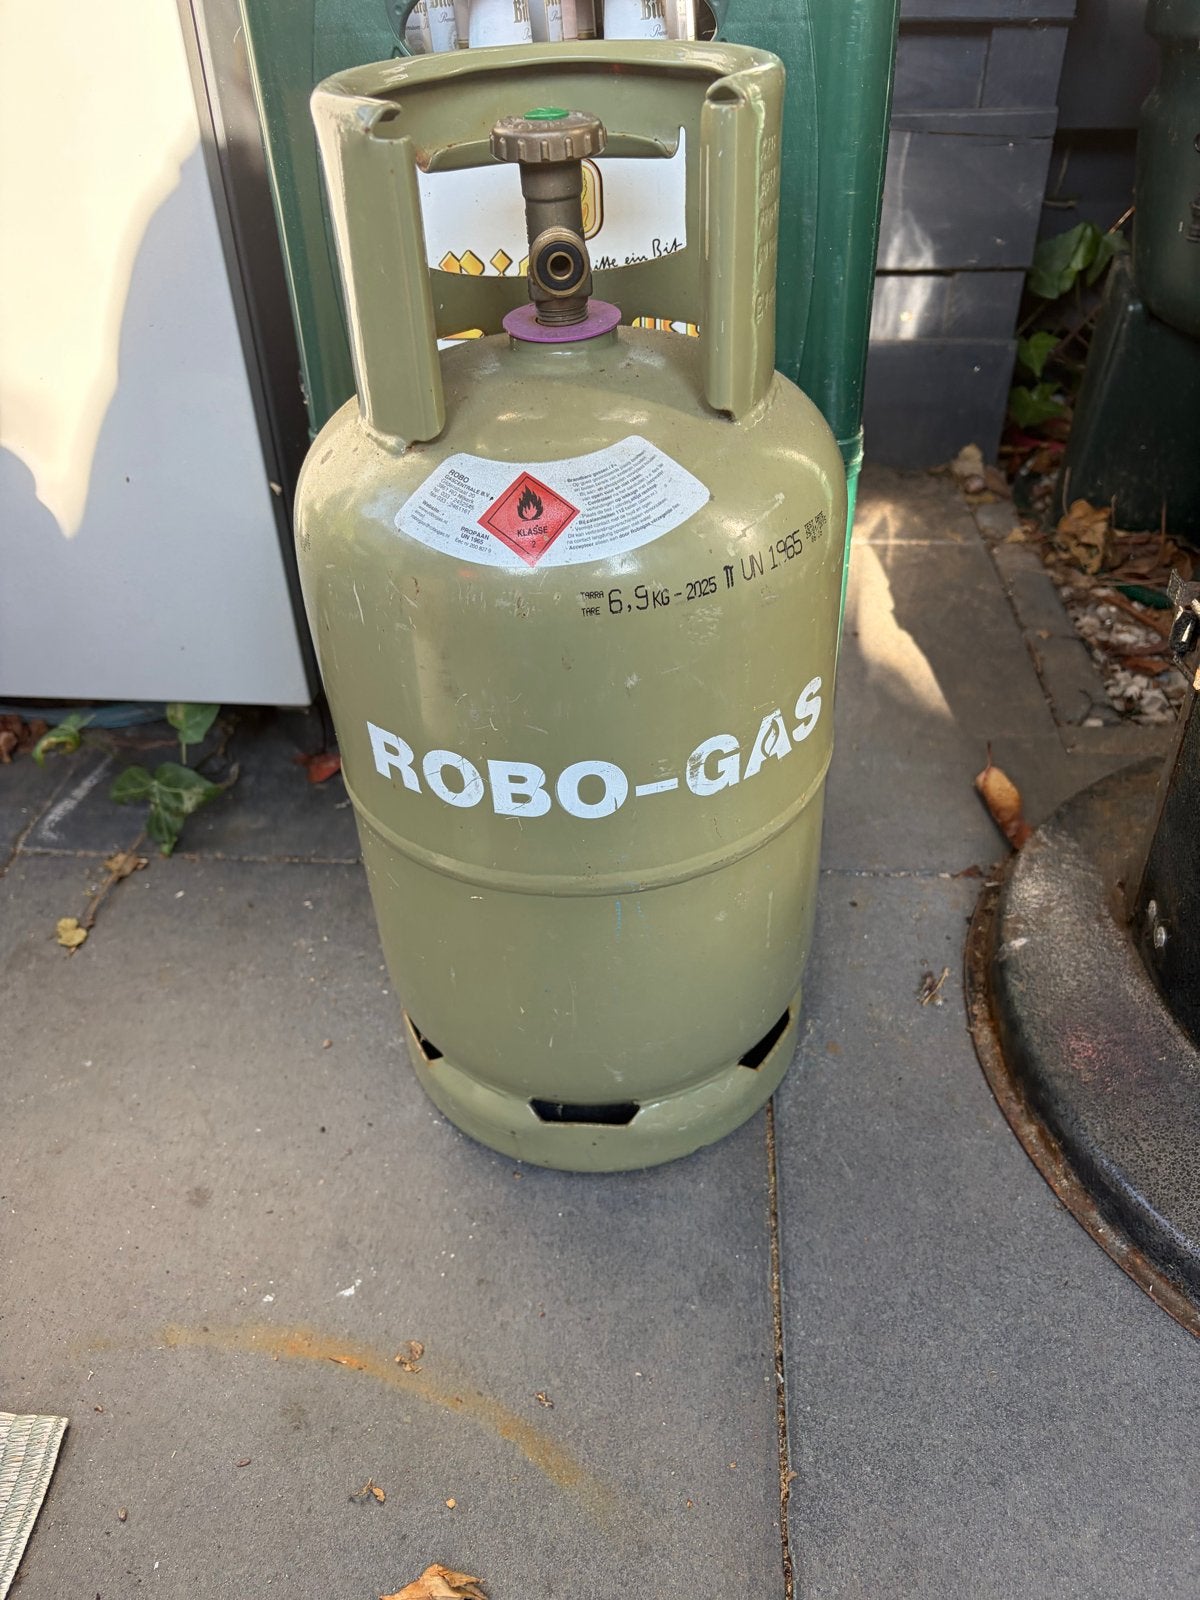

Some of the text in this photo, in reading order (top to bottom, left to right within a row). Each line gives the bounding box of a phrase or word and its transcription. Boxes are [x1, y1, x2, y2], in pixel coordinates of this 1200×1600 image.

[625, 252, 648, 266] ein
[652, 237, 683, 257] Bit
[448, 469, 470, 483] ROBO
[444, 474, 481, 495] GASCENTRALE
[460, 526, 490, 541] PROPAAN
[517, 525, 548, 537] KLASSE
[460, 532, 484, 545] UN 1965
[532, 540, 536, 548] 2
[685, 576, 717, 601] 2025
[740, 551, 764, 581] UN
[769, 529, 803, 570] 1965
[581, 607, 601, 617] TARE
[366, 676, 823, 819] ROBO-GAS
